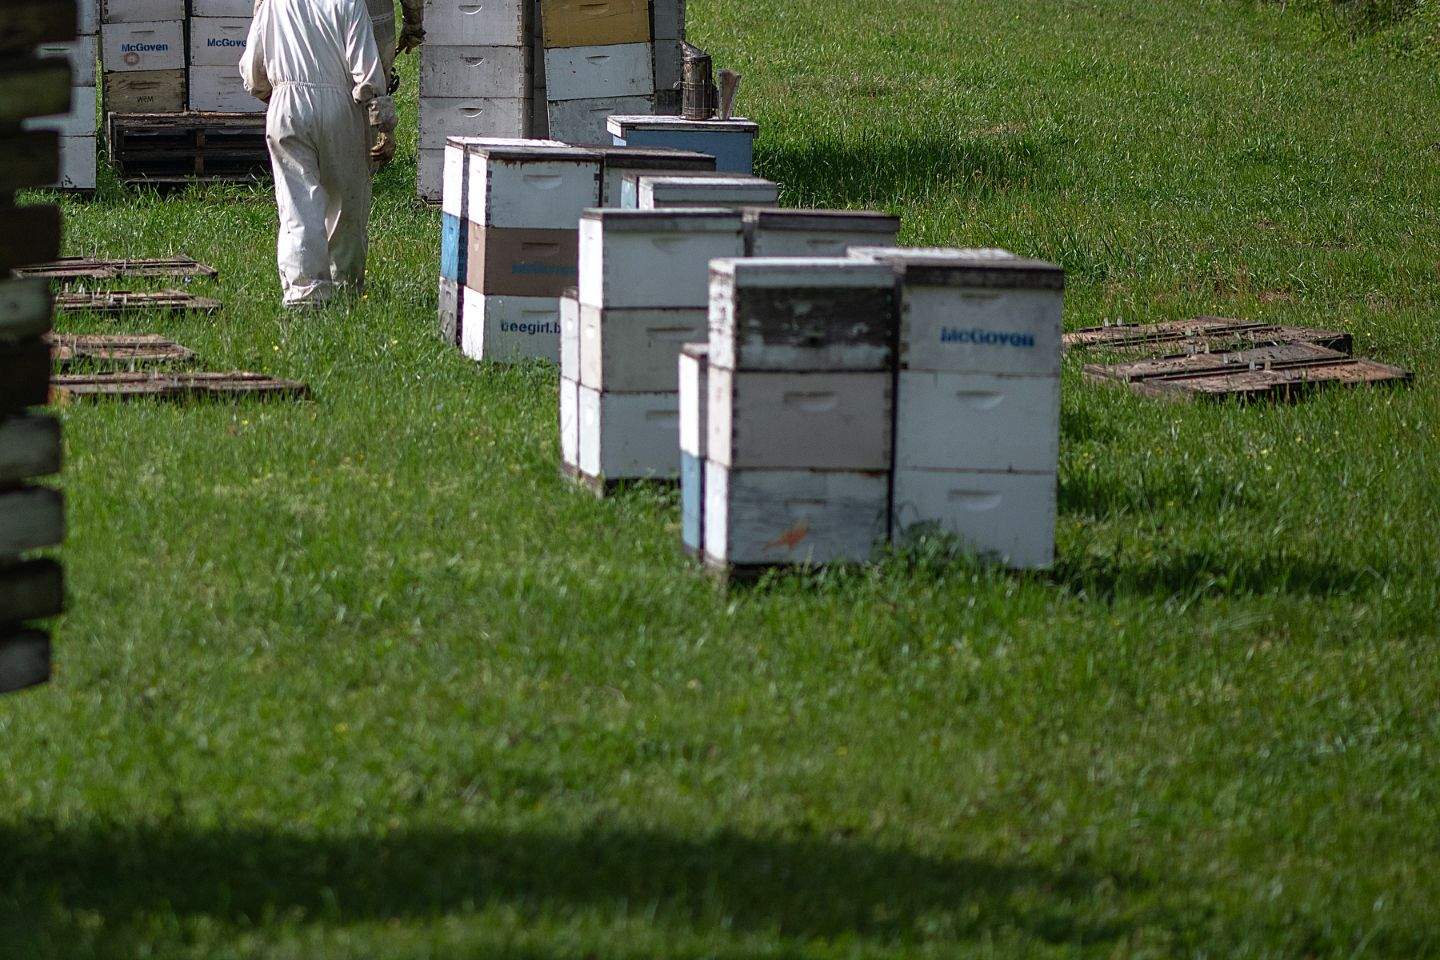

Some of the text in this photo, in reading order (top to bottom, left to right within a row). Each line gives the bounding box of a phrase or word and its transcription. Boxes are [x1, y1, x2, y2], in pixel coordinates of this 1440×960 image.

[121, 42, 169, 53] McGoven
[207, 38, 247, 48] McGove
[500, 320, 561, 335] beegirl.b
